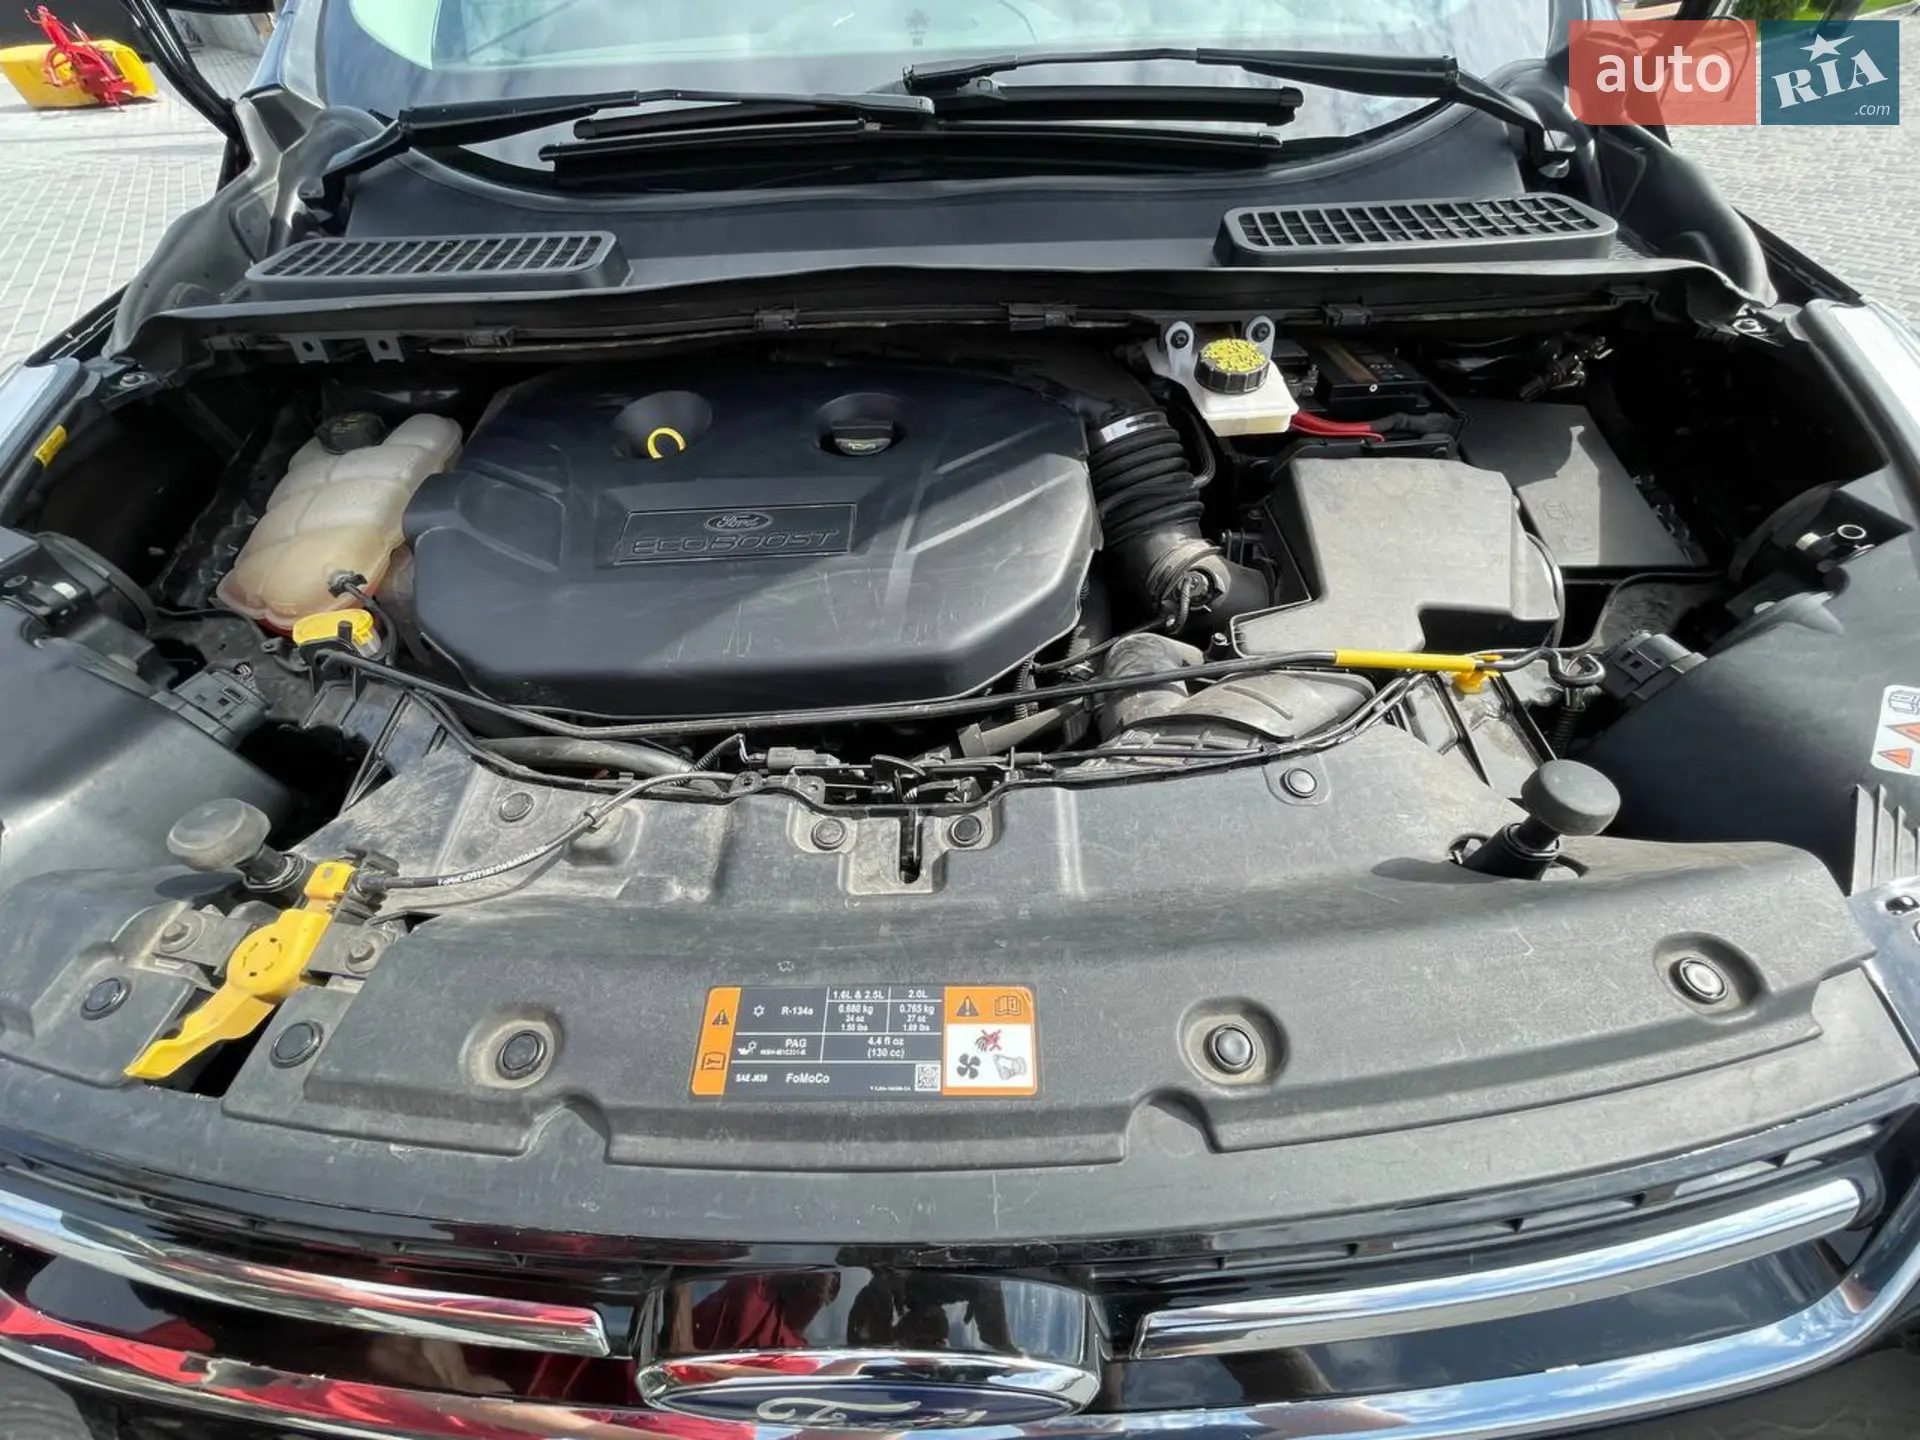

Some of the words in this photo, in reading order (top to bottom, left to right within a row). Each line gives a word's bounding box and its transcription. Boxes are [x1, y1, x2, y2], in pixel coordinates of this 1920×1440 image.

[716, 515, 760, 528] Ford
[632, 530, 840, 555] ECOBOOST
[864, 990, 884, 1000] 2.5L
[908, 989, 928, 999] 2.0L
[781, 1005, 814, 1016] R-134a
[863, 1003, 874, 1015] kg
[899, 1004, 923, 1014] 0.765
[924, 1004, 935, 1016] kg
[785, 1038, 807, 1049] PAG
[867, 1036, 882, 1046] 4.4
[892, 1038, 904, 1046] oz
[867, 1047, 888, 1059] (130
[889, 1047, 905, 1059] cc)
[785, 1072, 830, 1084] FoMoCo
[756, 1397, 988, 1428] Fd
